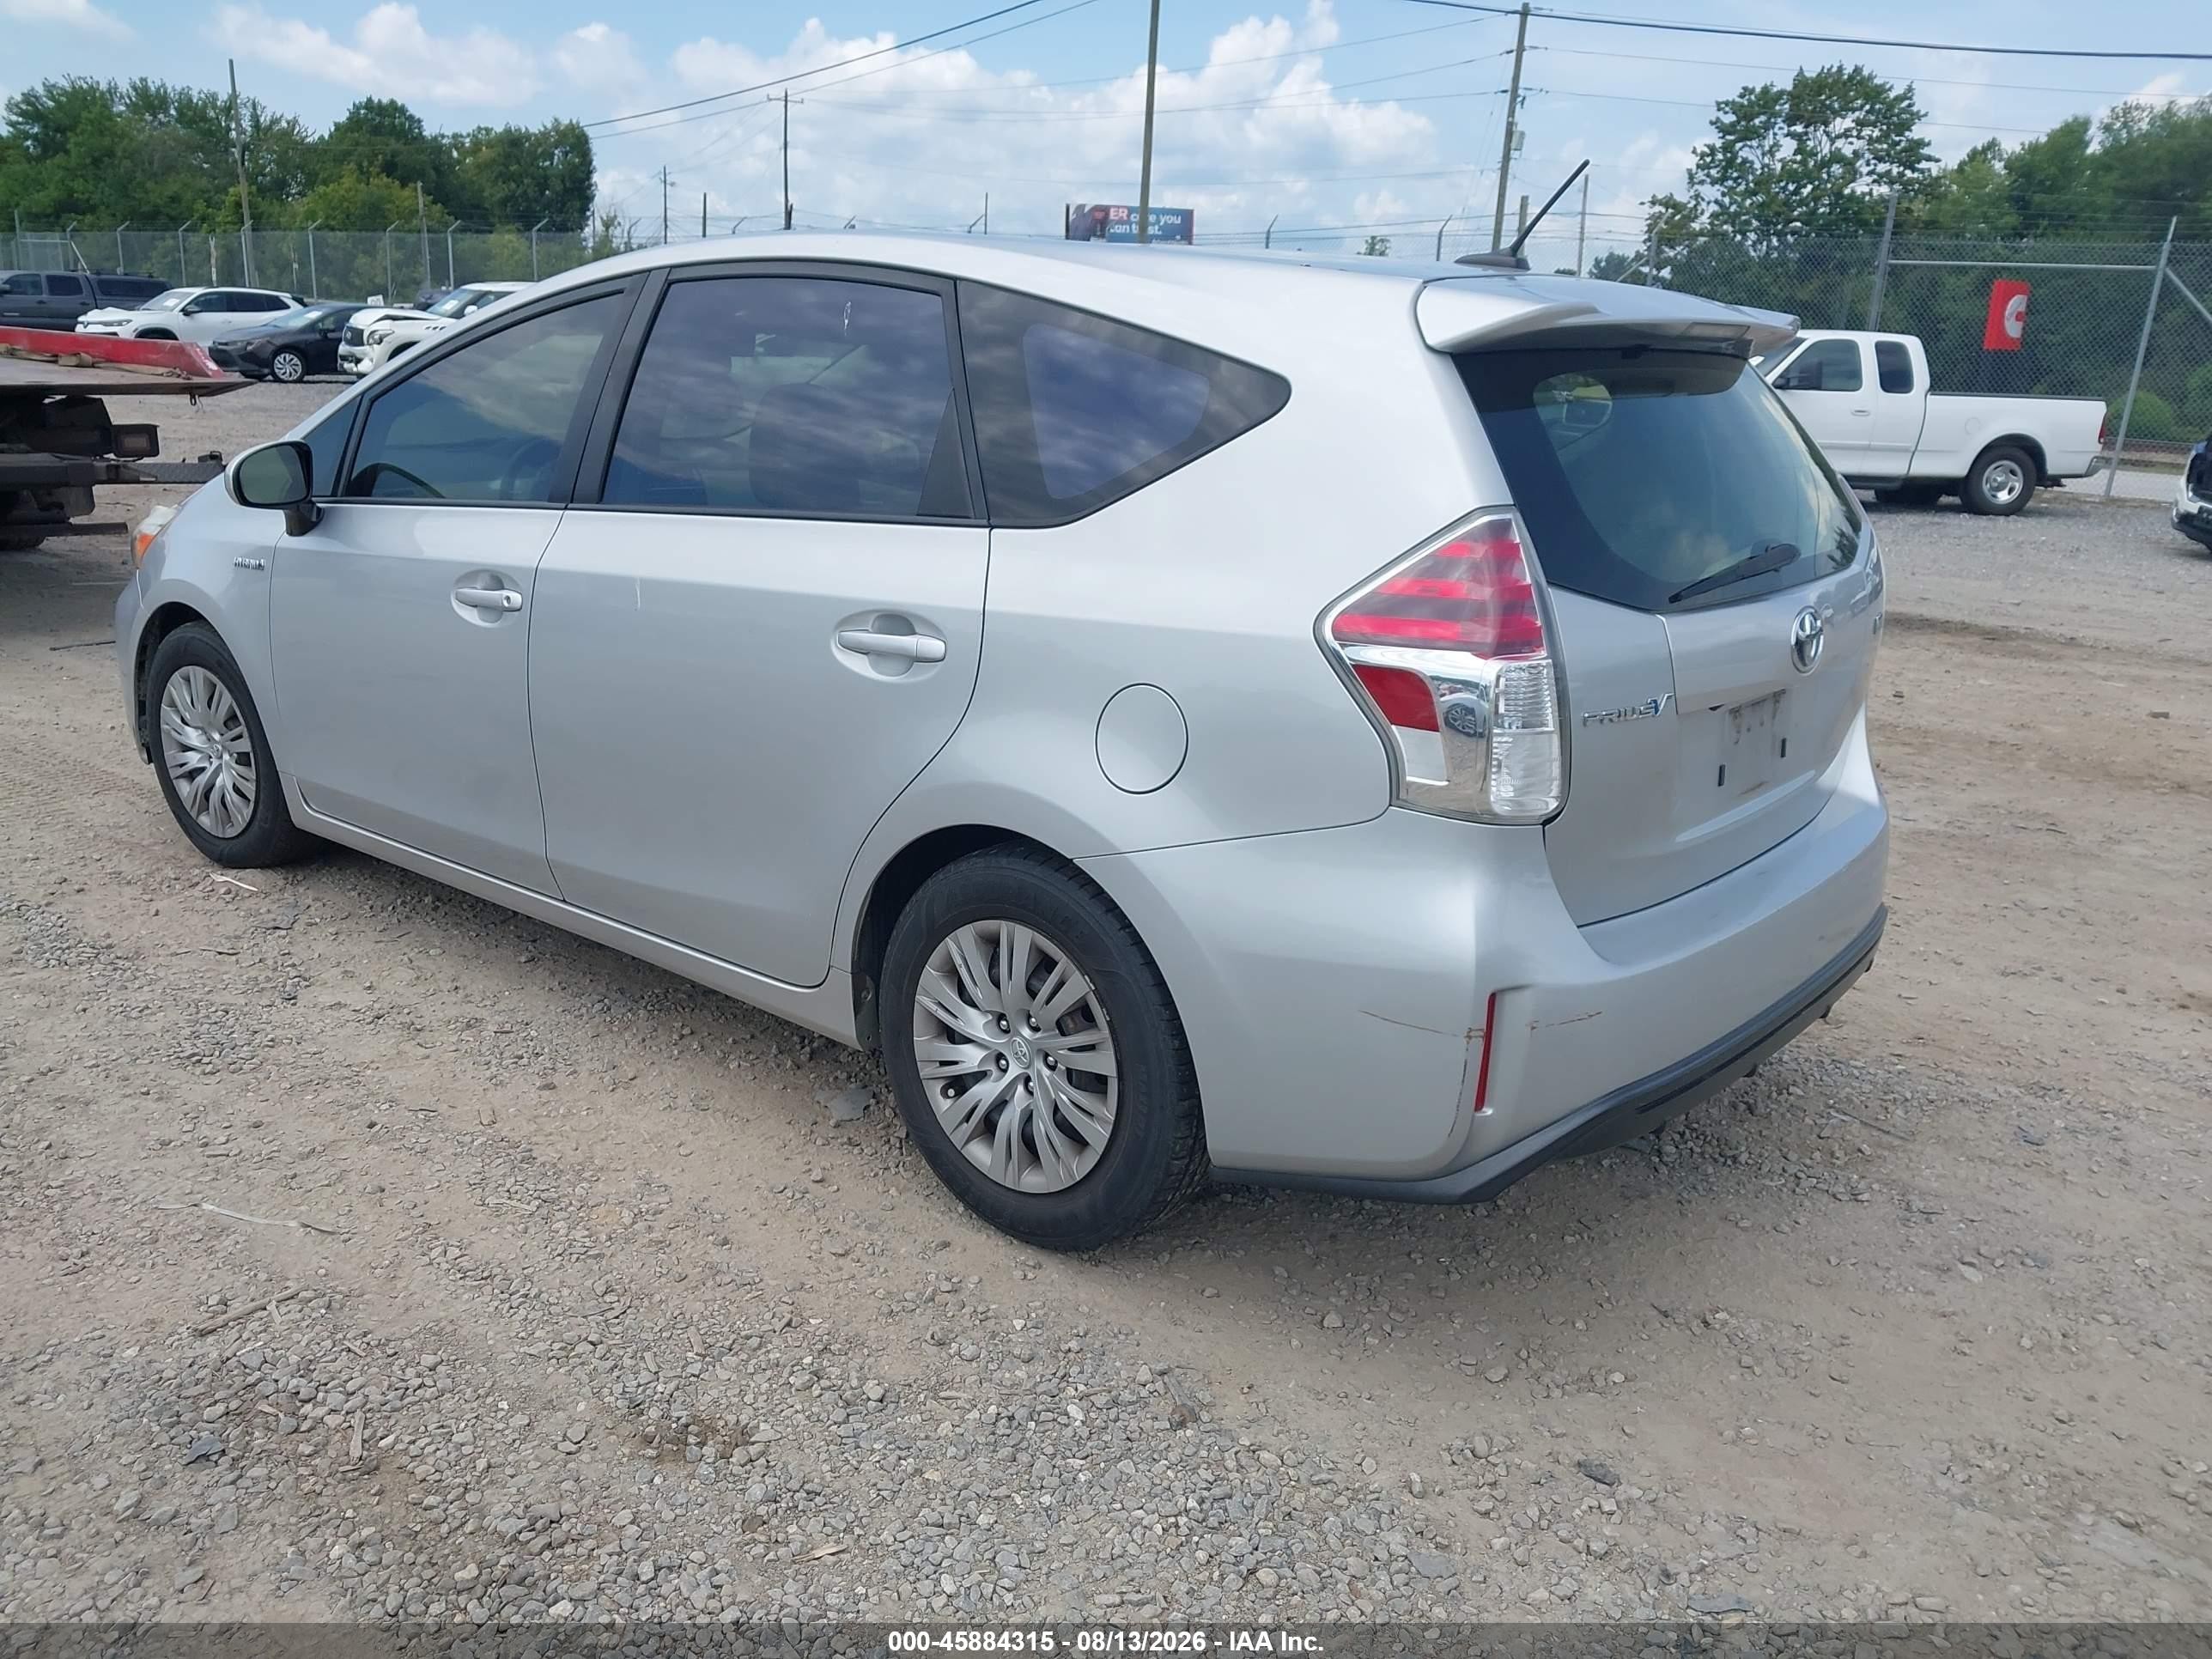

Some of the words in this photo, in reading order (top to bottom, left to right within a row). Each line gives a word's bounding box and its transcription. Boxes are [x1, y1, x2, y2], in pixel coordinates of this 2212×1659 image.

[1109, 207, 1128, 221] ER
[1159, 213, 1182, 226] you
[1583, 703, 1656, 726] PRIUS
